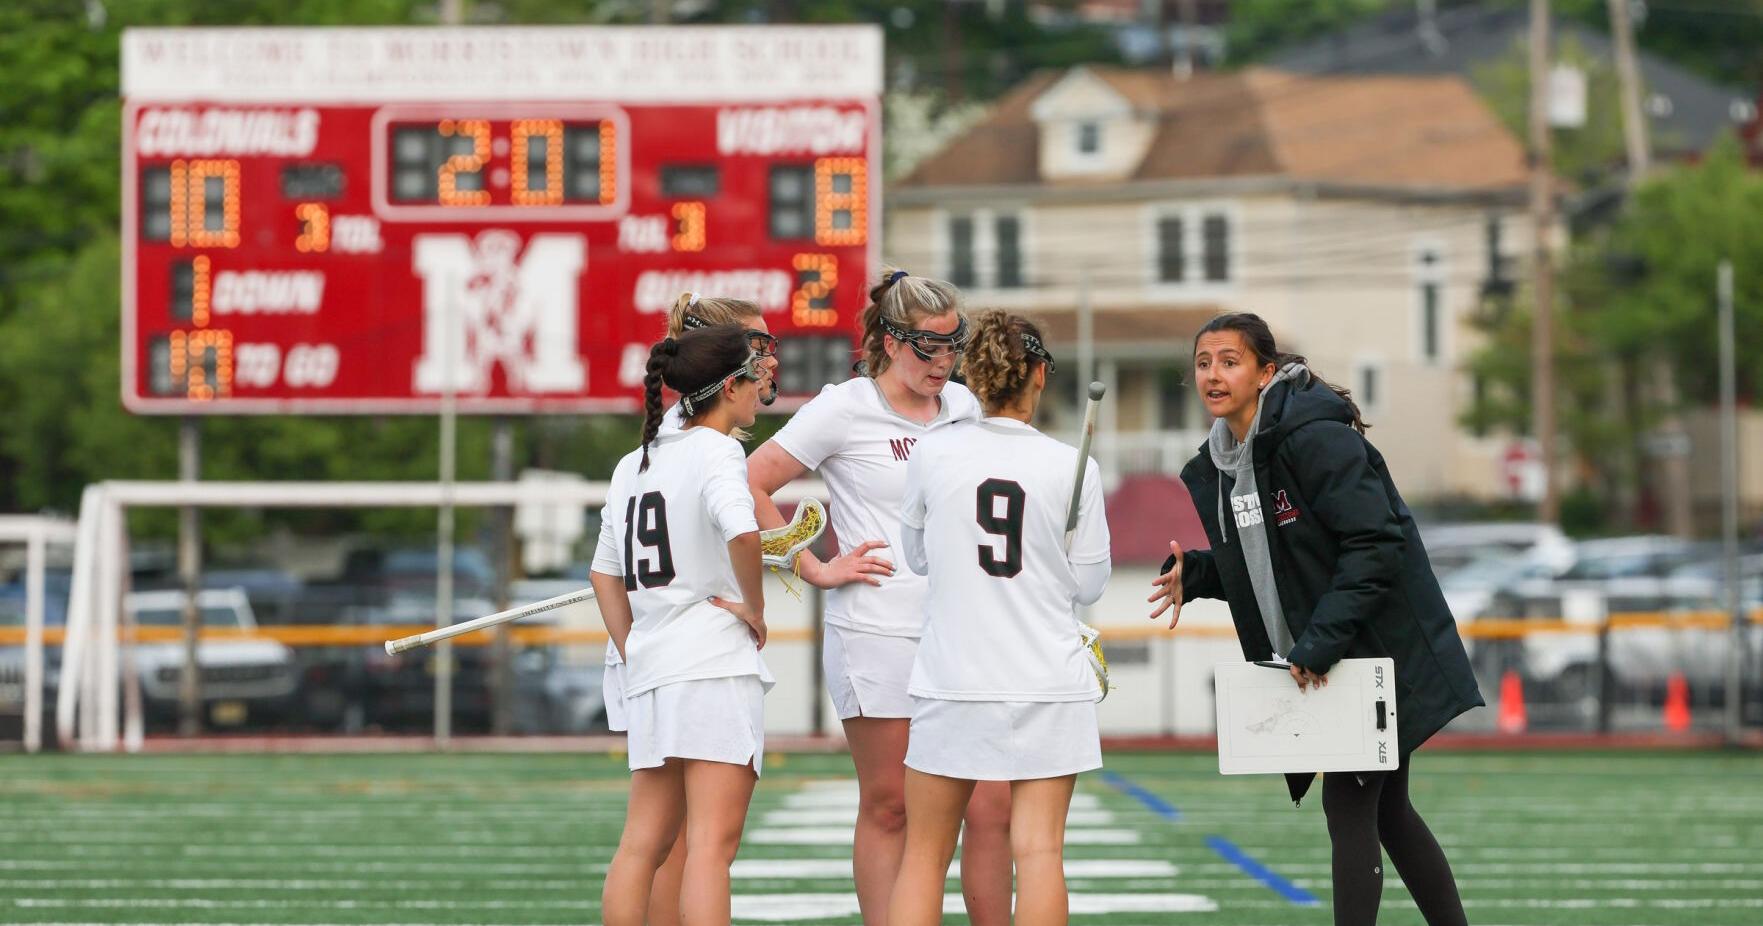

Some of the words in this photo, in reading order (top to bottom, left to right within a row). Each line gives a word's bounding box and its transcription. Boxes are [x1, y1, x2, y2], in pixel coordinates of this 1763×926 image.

[717, 108, 866, 155] VISITOR
[170, 159, 240, 248] 10
[296, 202, 329, 252] 3
[672, 201, 706, 252] 3
[815, 157, 867, 247] 8
[212, 270, 325, 315] DOWN
[412, 232, 589, 395] M
[634, 269, 792, 314] QUARTER
[792, 253, 838, 327] 2
[235, 343, 281, 388] TO
[284, 343, 340, 388] GO
[624, 490, 676, 592] 19
[976, 478, 1025, 578] 9
[1375, 666, 1384, 688] STX
[1378, 741, 1387, 764] STX
